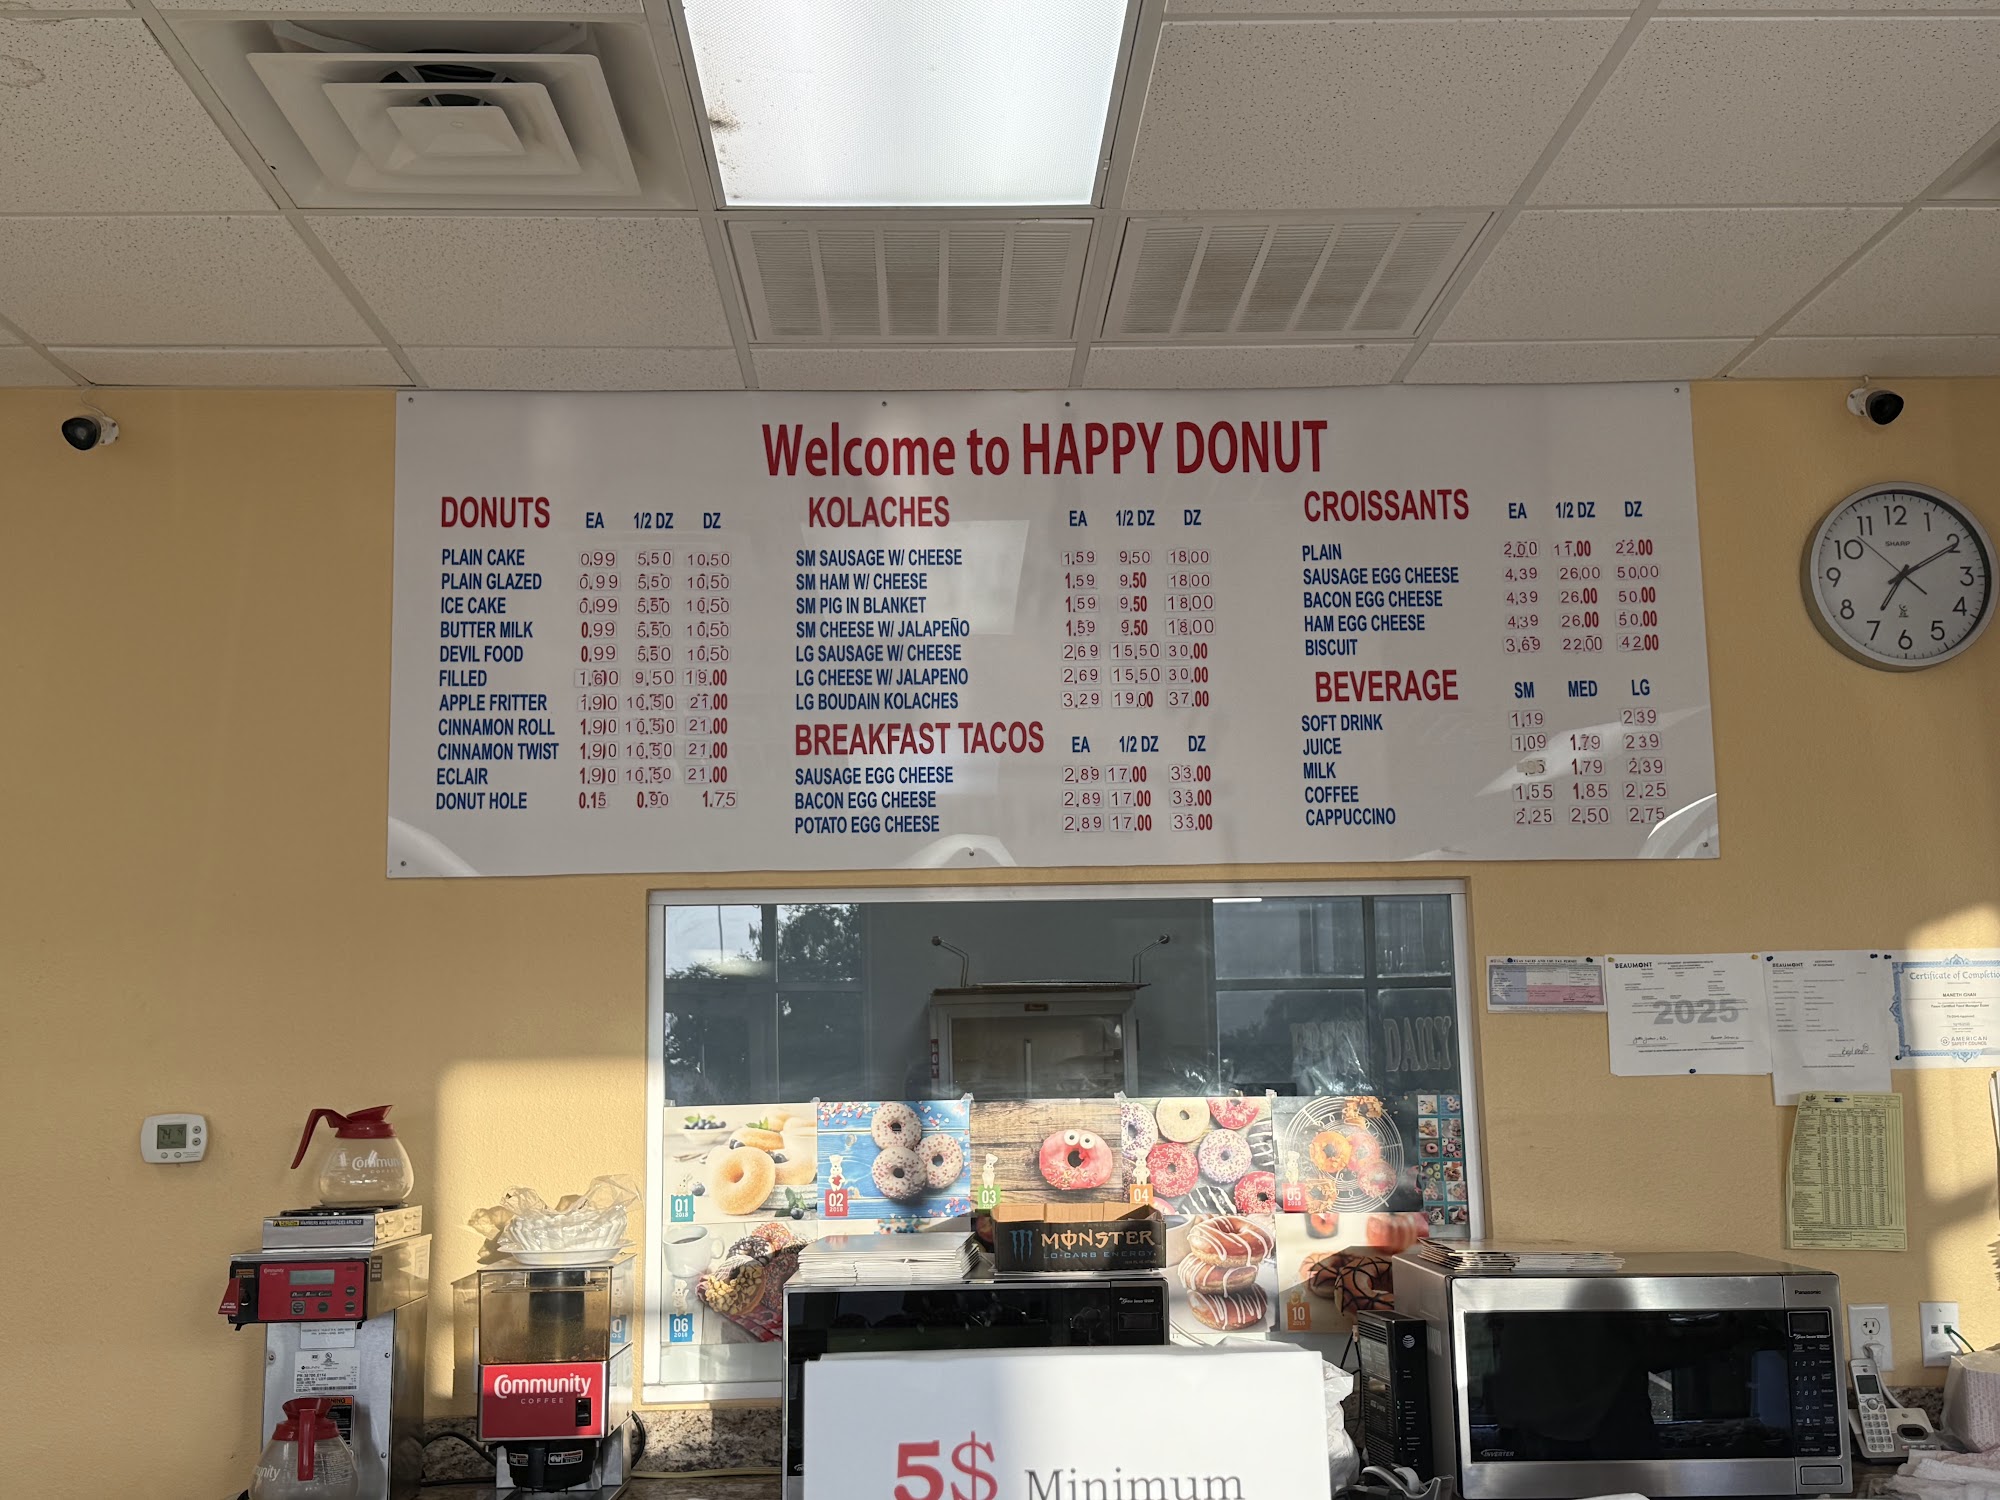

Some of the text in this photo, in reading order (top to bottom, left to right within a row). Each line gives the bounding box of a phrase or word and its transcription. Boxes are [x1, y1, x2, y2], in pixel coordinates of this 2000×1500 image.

[762, 420, 1328, 477] Welcome to HAPPY DONUT
[441, 496, 550, 528] DONUTS
[809, 496, 950, 528] KOLACHES
[1304, 488, 1469, 522] CROISSANTS
[1509, 503, 1527, 519] EA
[1556, 502, 1595, 518] 1/2 DZ
[1625, 501, 1642, 517] DZ
[586, 512, 604, 528] EA
[634, 512, 673, 529] 1/2 DZ
[704, 513, 721, 529] DZ
[1070, 510, 1087, 526] EA
[1116, 510, 1155, 526] 1/2 DZ
[1184, 509, 1201, 525] DZ
[1884, 505, 1907, 526] 12
[1924, 512, 1931, 532] 1
[1857, 516, 1873, 536] 11
[1302, 544, 1342, 561] PLAIN
[1834, 539, 1864, 560] 10
[1946, 534, 1960, 554] 2
[442, 549, 525, 566] PLAIN CAKE
[796, 549, 962, 566] SM SAUSAGE W/ CHEESE
[442, 573, 542, 590] PLAIN GLAZED
[796, 573, 927, 590] SM HAM W/ CHEESE
[1303, 567, 1459, 585] SAUSAGE EGG CHEESE
[1826, 567, 1842, 588] 9
[1960, 566, 1974, 586] 3
[441, 597, 506, 614] ICE CAKE
[796, 597, 926, 614] SM PIG IN BLANKET
[1304, 590, 1443, 608] BACON EGG CHEESE
[1952, 596, 1968, 616] 4
[1840, 599, 1855, 620] 8
[441, 621, 533, 638] BUTTER MILK
[796, 618, 969, 638] SM CHEESE W/ JALAPEÑO
[1305, 614, 1425, 632] HAM EGG CHEESE
[1866, 620, 1880, 641] 7
[1930, 620, 1945, 641] 5
[1305, 639, 1358, 656] BISCUIT
[1898, 630, 1912, 650] 6
[440, 645, 523, 662] DEVIL FOOD
[796, 644, 961, 662] LG SAUSAGE W/ CHEESE
[440, 670, 487, 686] FILLED
[796, 668, 968, 686] LG CHEESE W/ JALAPENO
[1315, 669, 1458, 703] BEVERAGE
[1515, 682, 1534, 699] SM
[1568, 680, 1597, 697] MED
[1632, 679, 1650, 696] LG
[439, 694, 547, 711] APPLE FRITTER
[796, 692, 958, 710] LG BOUDAIN KOLACHES
[438, 718, 555, 736] CINNAMON ROLL
[1302, 714, 1383, 732] SOFT DRINK
[796, 721, 1044, 756] BREAKFAST TACOS
[1072, 736, 1090, 753] EA
[1119, 736, 1159, 752] 1/2 DZ
[1188, 735, 1206, 752] DZ
[1303, 737, 1342, 755] JUICE
[438, 743, 559, 760] CINNAMON TWIST
[437, 768, 488, 785] ECLAIR
[795, 766, 953, 785] SAUSAGE EGG CHEESE
[1304, 762, 1336, 779] MILK
[436, 792, 527, 810] DONUT HOLE
[795, 791, 936, 809] BACON EGG CHEESE
[1305, 786, 1359, 803] COFFEE
[795, 815, 939, 834] POTATO EGG CHEESE
[1306, 808, 1396, 826] CAPPUCCINO
[1909, 970, 2000, 980] Certificate of Completio
[1653, 998, 1740, 1025] 2025
[828, 1193, 844, 1207] 02
[982, 1190, 996, 1204] 03
[1134, 1188, 1149, 1202] 04
[1286, 1188, 1302, 1201] 05
[674, 1198, 690, 1212] 01
[1041, 1228, 1156, 1250] MONSTER
[1043, 1250, 1154, 1259] LO-CARB ENERGY
[1292, 1306, 1305, 1320] 10
[673, 1318, 689, 1332] 06
[494, 1372, 592, 1399] Community
[894, 1431, 1246, 1500] 5$ Minimum
